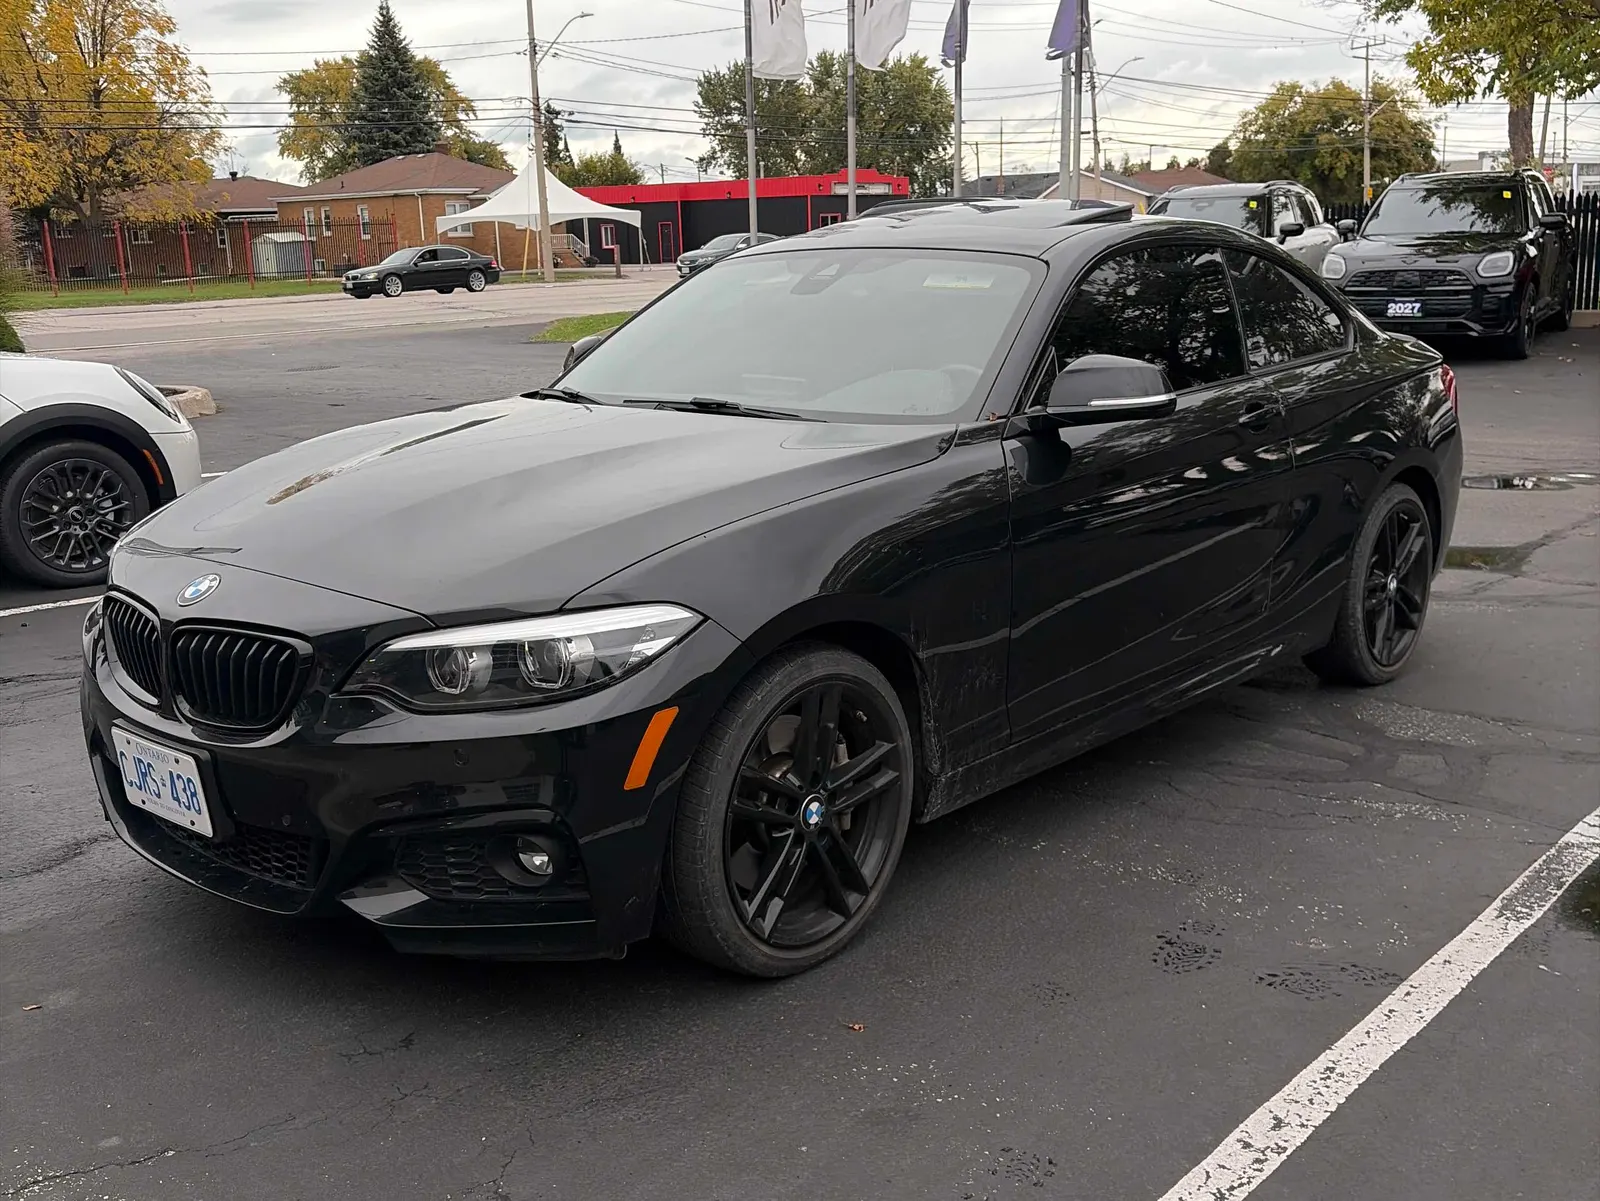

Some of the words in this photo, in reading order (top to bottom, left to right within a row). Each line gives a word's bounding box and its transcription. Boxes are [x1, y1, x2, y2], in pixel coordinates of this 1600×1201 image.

[1387, 302, 1421, 314] 2027
[119, 750, 161, 799] CJRS
[169, 770, 201, 815] 438
